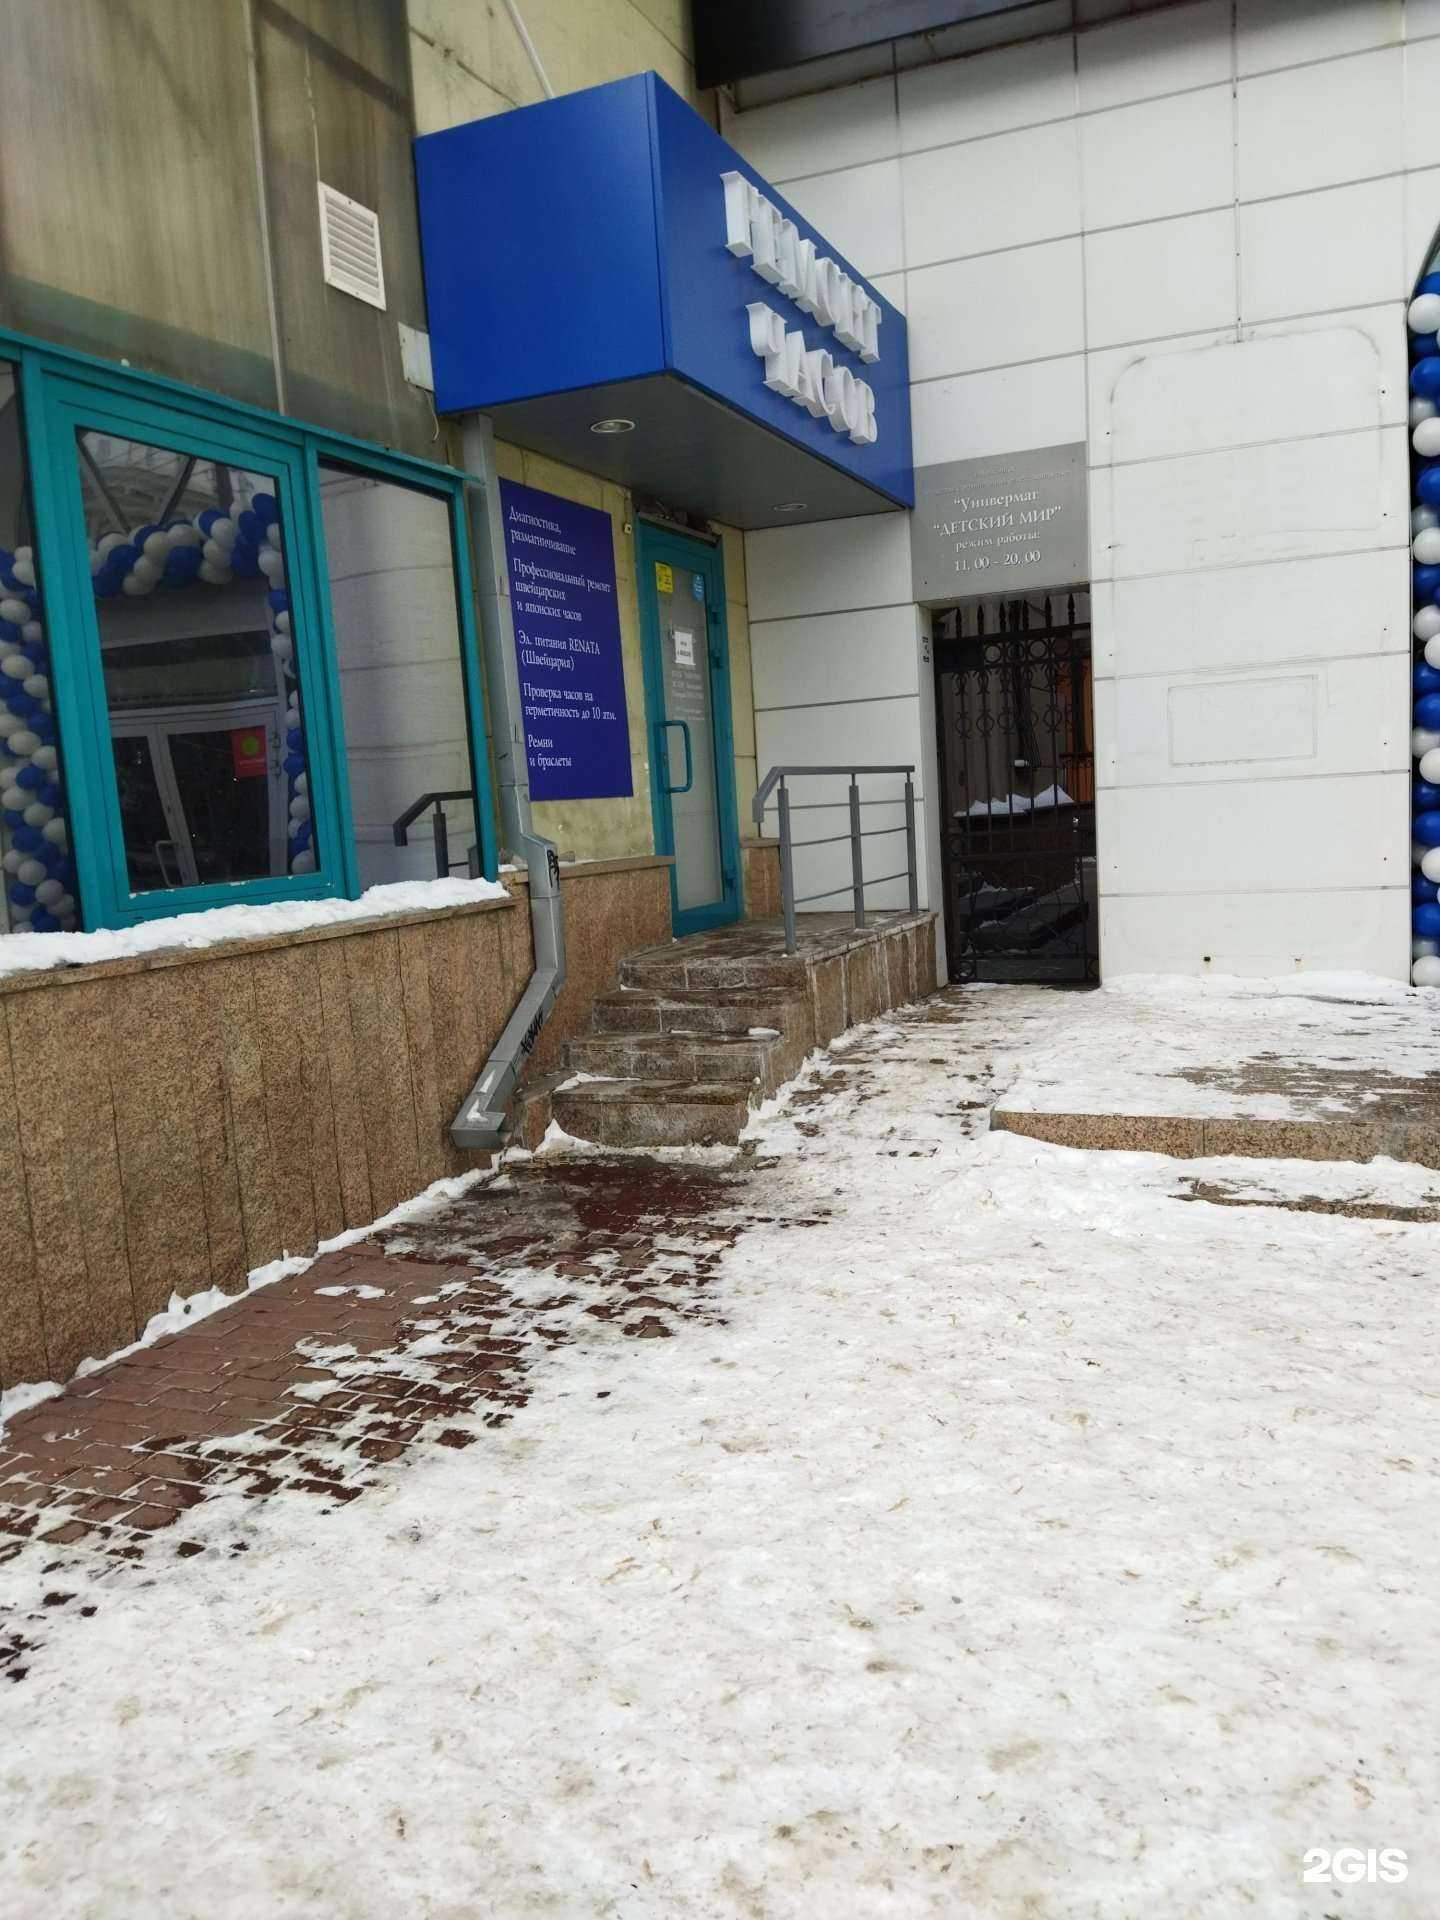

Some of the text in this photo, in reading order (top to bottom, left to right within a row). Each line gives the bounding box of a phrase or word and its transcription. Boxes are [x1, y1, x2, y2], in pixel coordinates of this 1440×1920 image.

[509, 505, 561, 534] Диагностика,
[956, 538, 993, 552] режим
[513, 558, 611, 592] Профессиональный ремонт
[515, 581, 566, 601] швейцарских
[516, 600, 582, 621] и японских часов
[535, 636, 567, 650] питания
[569, 637, 601, 655] RENATA
[521, 649, 575, 671] (Швейцария)
[523, 682, 593, 702] Проверка часов на
[525, 705, 580, 719] герметичность
[581, 710, 590, 720] до
[592, 706, 601, 720] 10
[528, 734, 553, 748] Ремни
[530, 753, 572, 770] и браслеты
